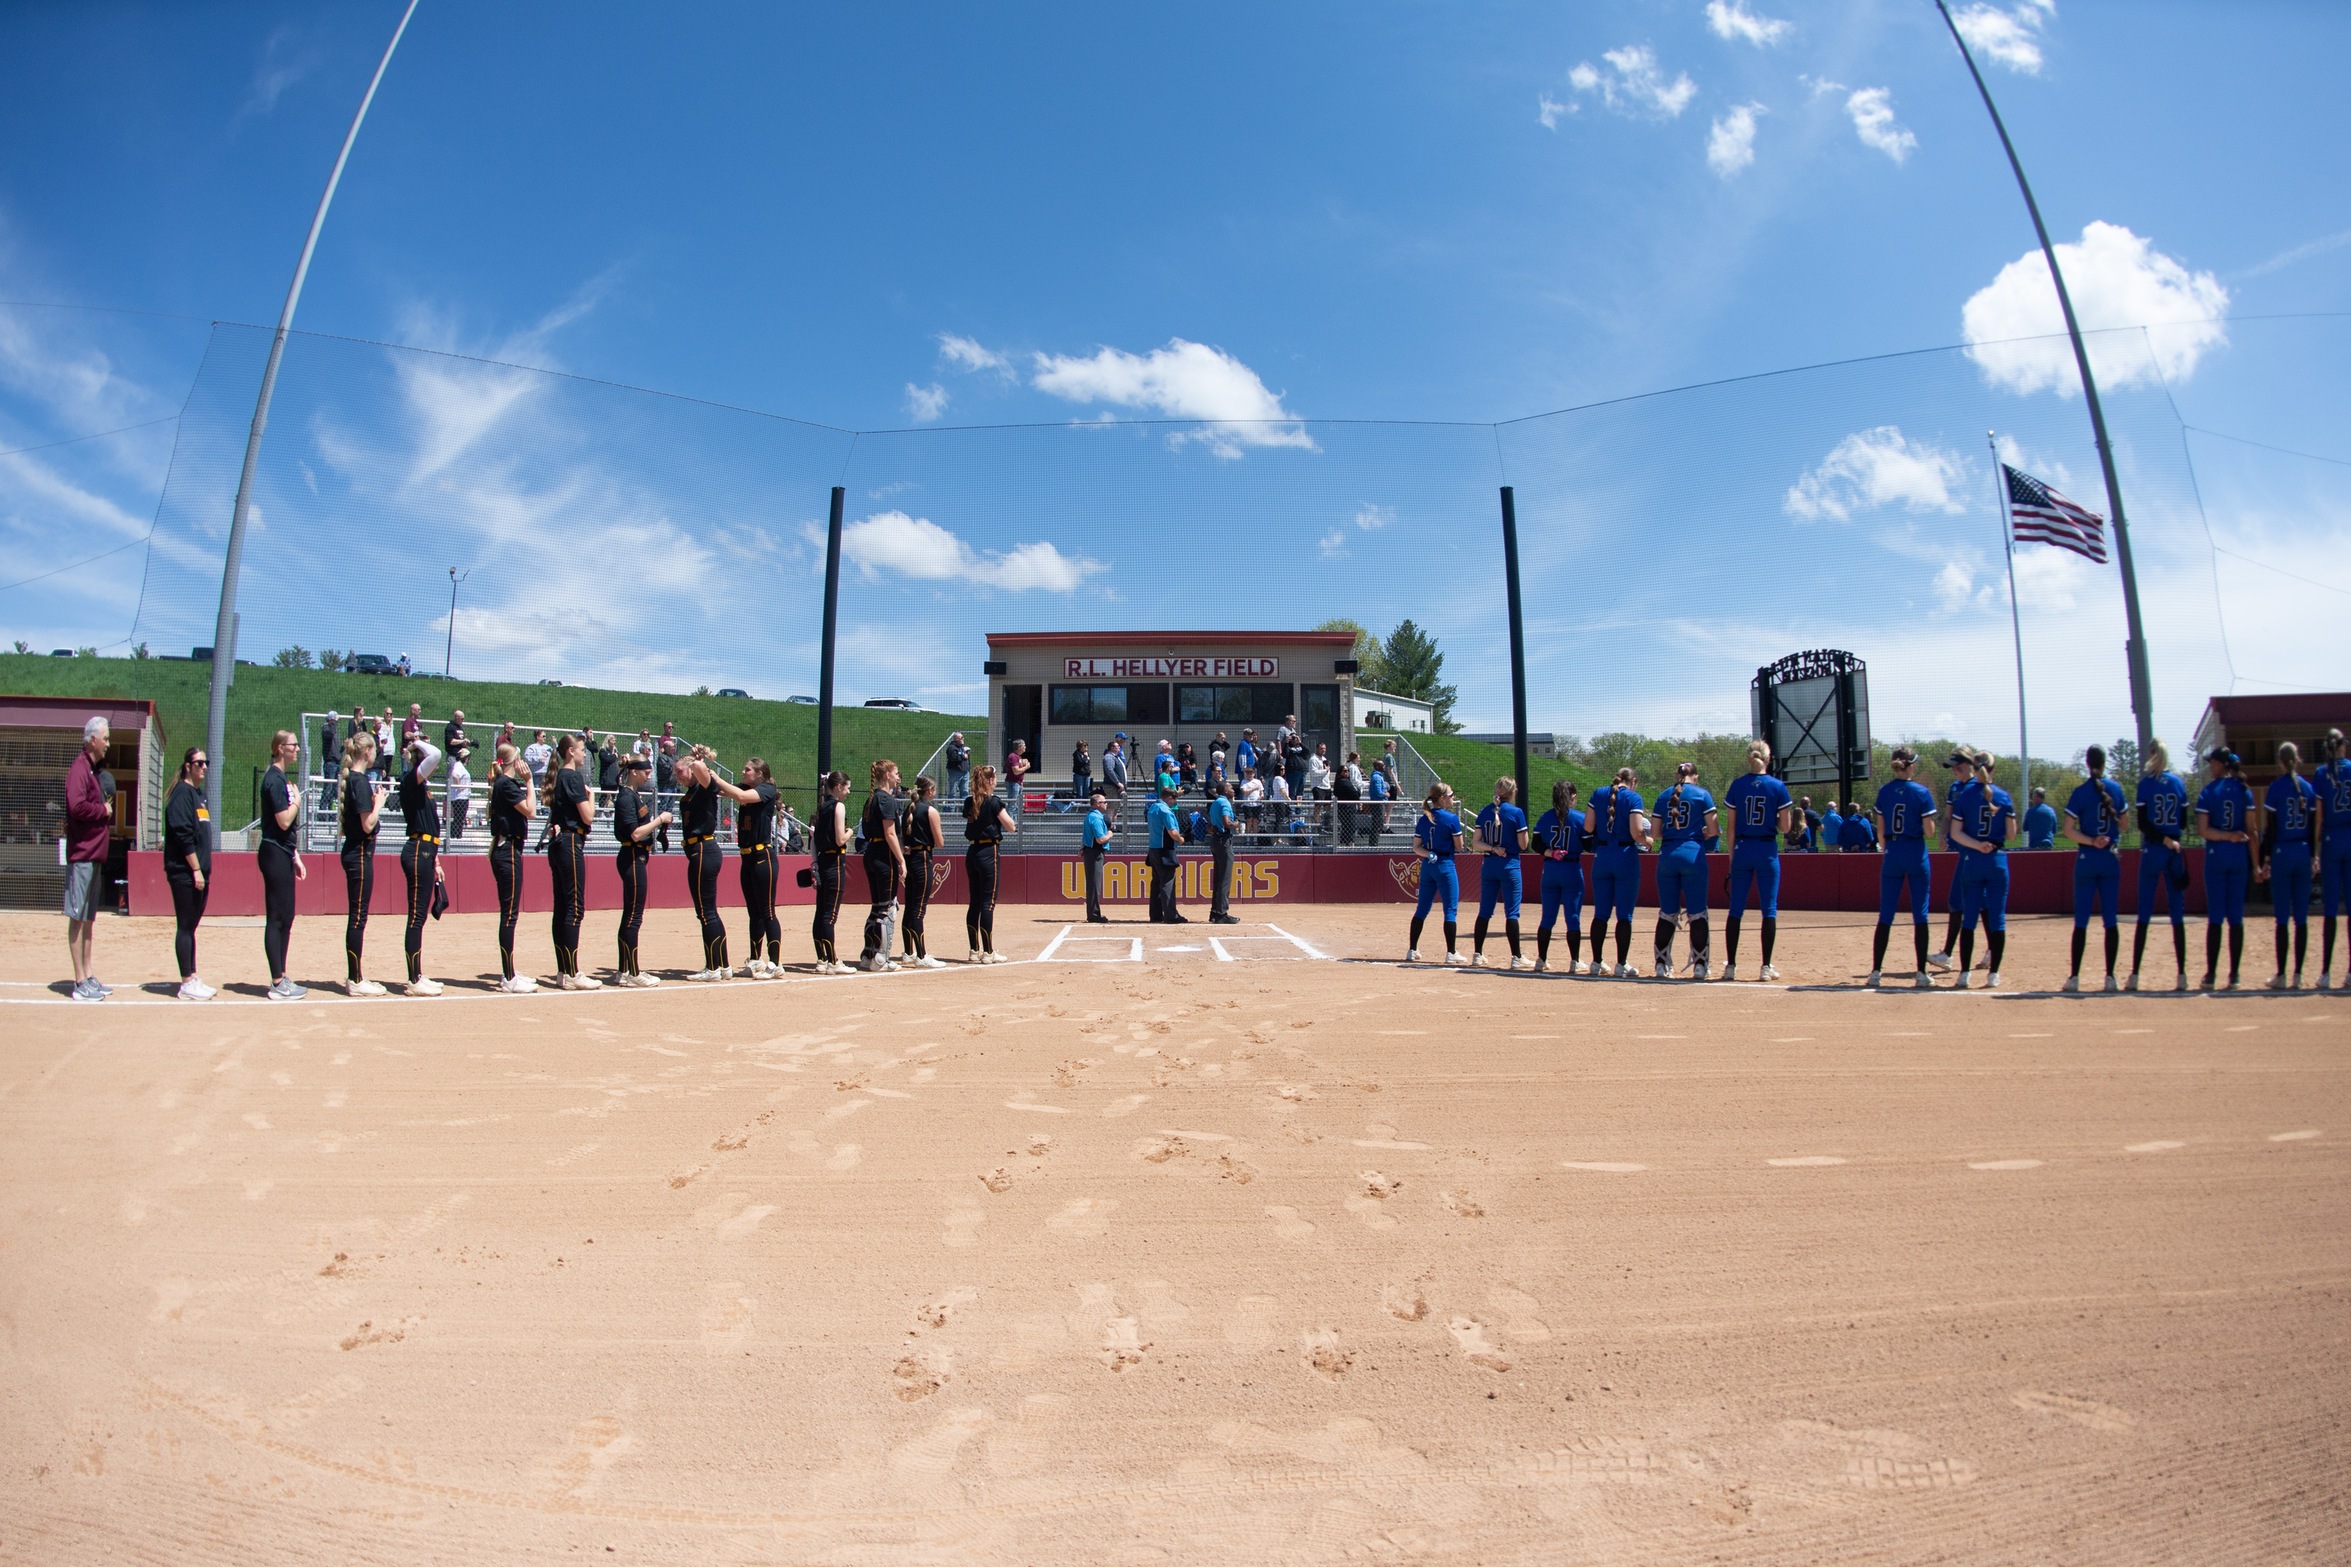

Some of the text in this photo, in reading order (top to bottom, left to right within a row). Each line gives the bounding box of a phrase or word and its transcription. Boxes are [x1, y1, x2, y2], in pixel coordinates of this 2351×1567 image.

[1067, 659, 1275, 677] R.L. HELLYER FIELD
[1745, 795, 1767, 826] 15
[1891, 803, 1906, 834] 6
[1977, 804, 1993, 837] 5
[2097, 802, 2111, 835] 9
[2153, 793, 2179, 826] 32
[2222, 800, 2235, 830] 3
[1484, 819, 1504, 846] 10
[1550, 825, 1572, 851] 21
[1061, 860, 1279, 899] WARIORS
